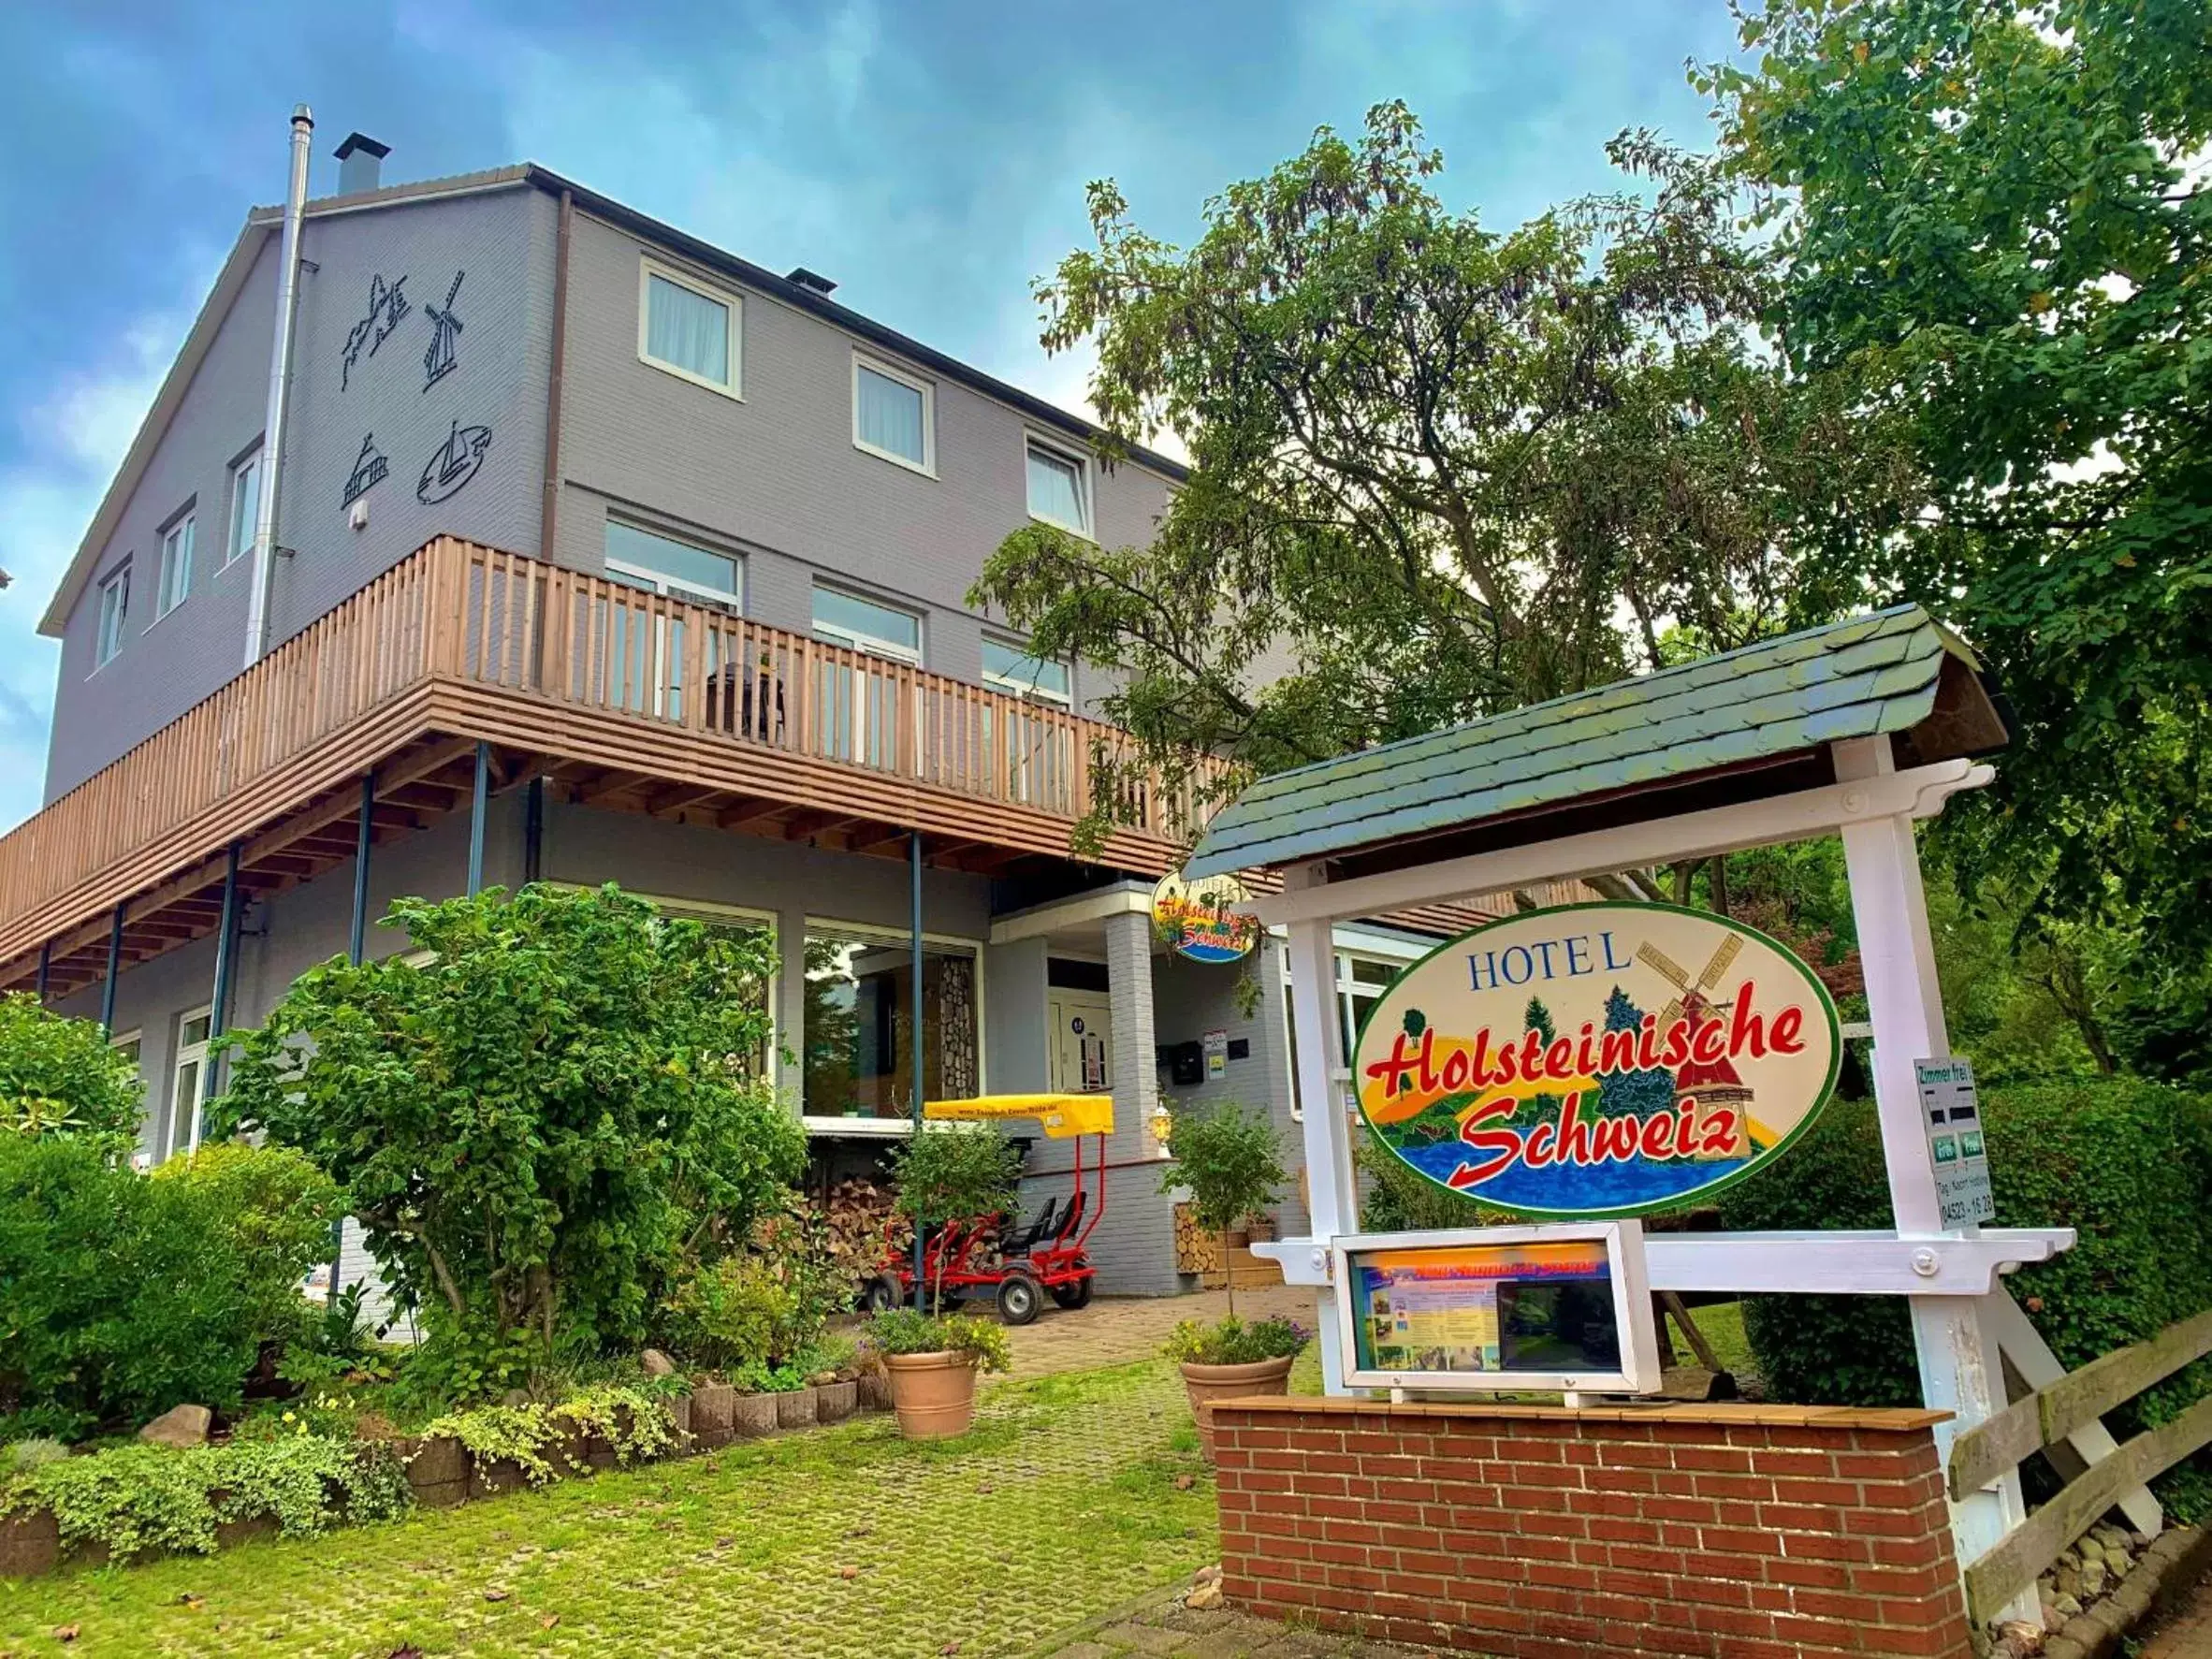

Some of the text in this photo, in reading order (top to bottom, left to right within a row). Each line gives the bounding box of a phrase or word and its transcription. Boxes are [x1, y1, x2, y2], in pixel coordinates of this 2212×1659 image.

[1466, 932, 1633, 992] HOTEL
[1367, 980, 1810, 1099] Holsteinische
[1918, 1065, 1951, 1084] Zimmer
[1952, 1062, 1968, 1082] frei
[1447, 1091, 1741, 1189] Schweiz
